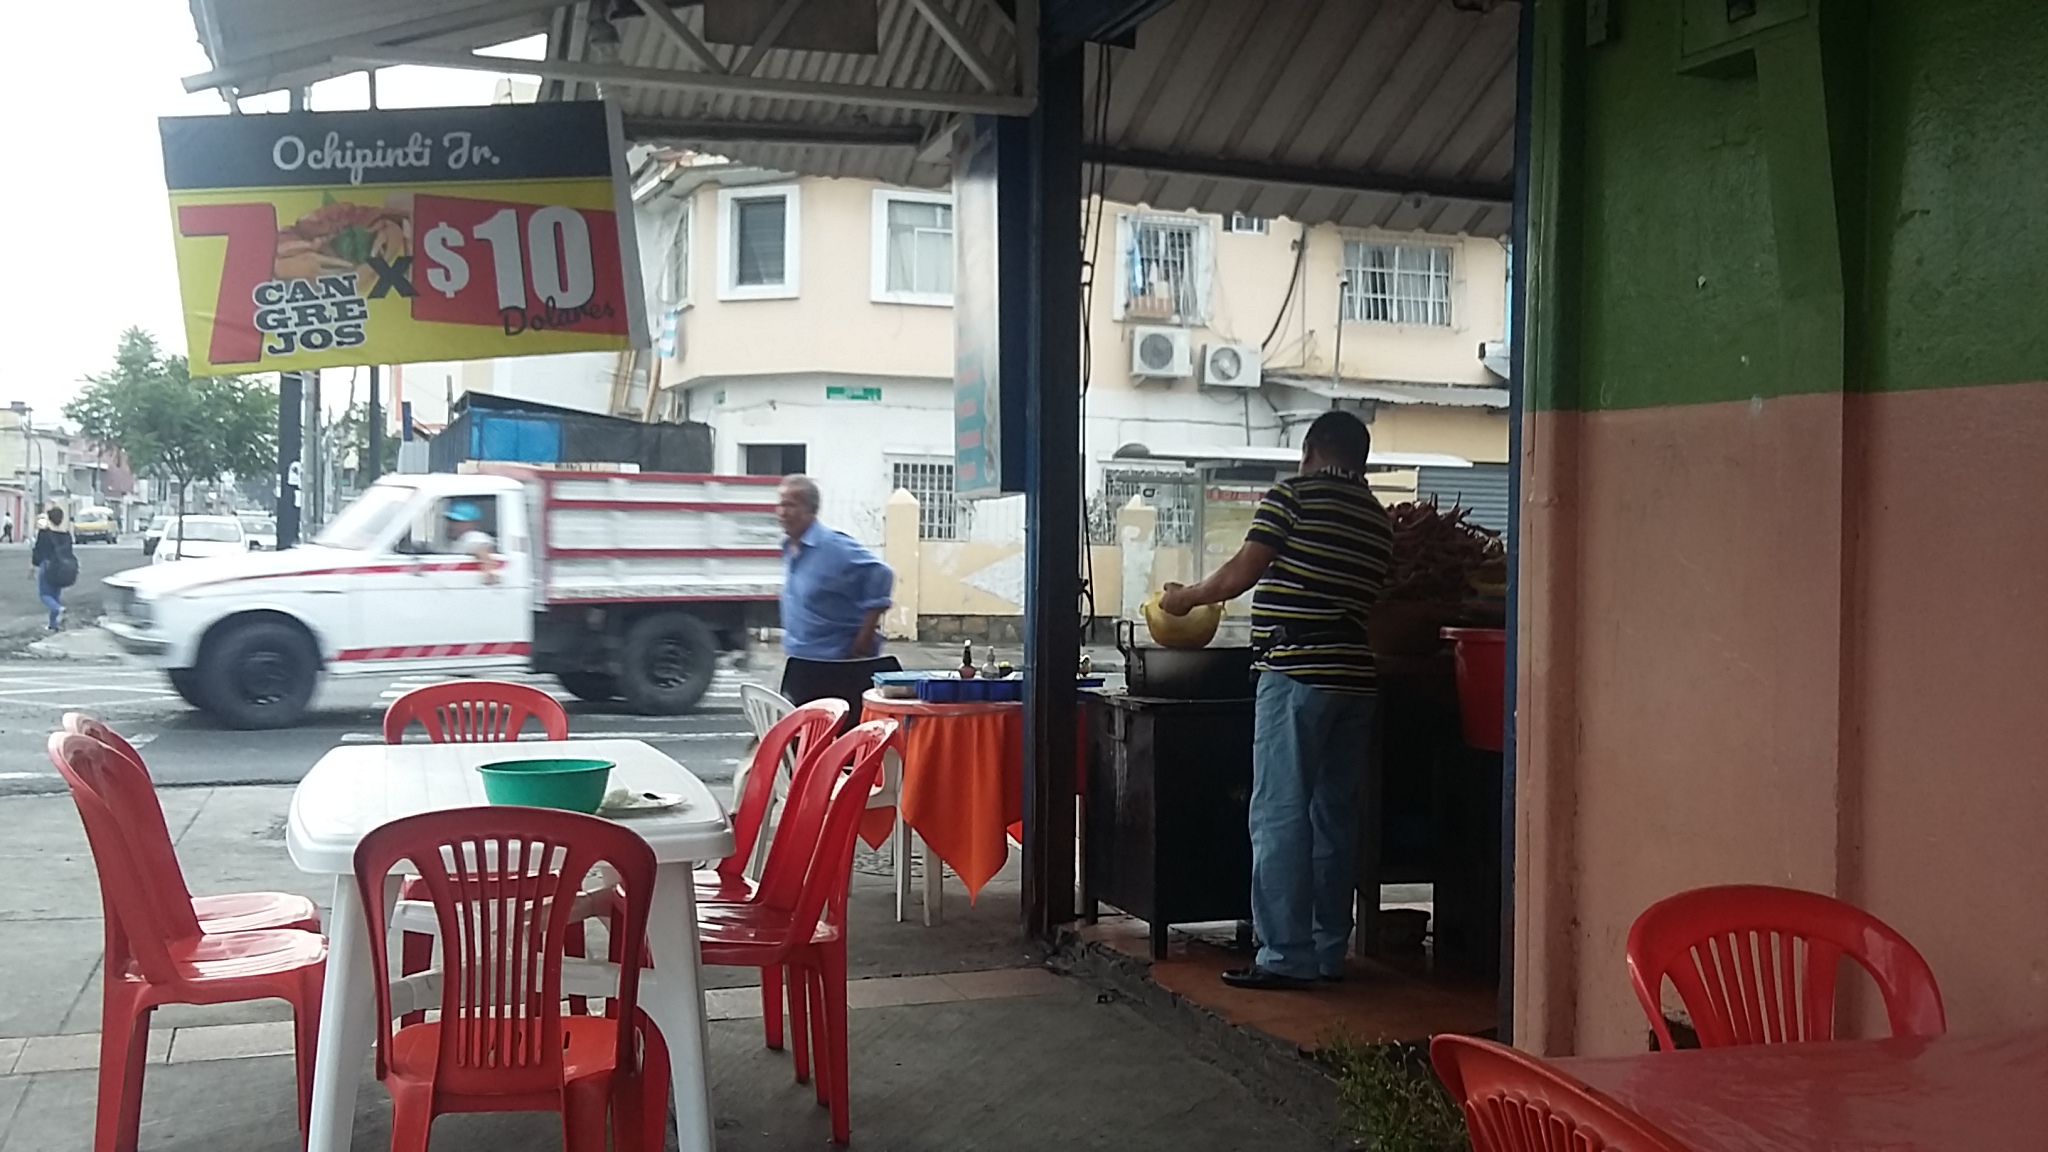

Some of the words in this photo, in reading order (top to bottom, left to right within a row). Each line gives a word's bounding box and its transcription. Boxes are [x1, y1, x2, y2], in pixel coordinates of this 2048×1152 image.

[273, 131, 433, 185] Ochipinti
[442, 131, 500, 169] Jr.
[178, 203, 278, 364] 7
[254, 274, 358, 305] CAN
[255, 298, 369, 331] GRE
[267, 323, 366, 355] JOS
